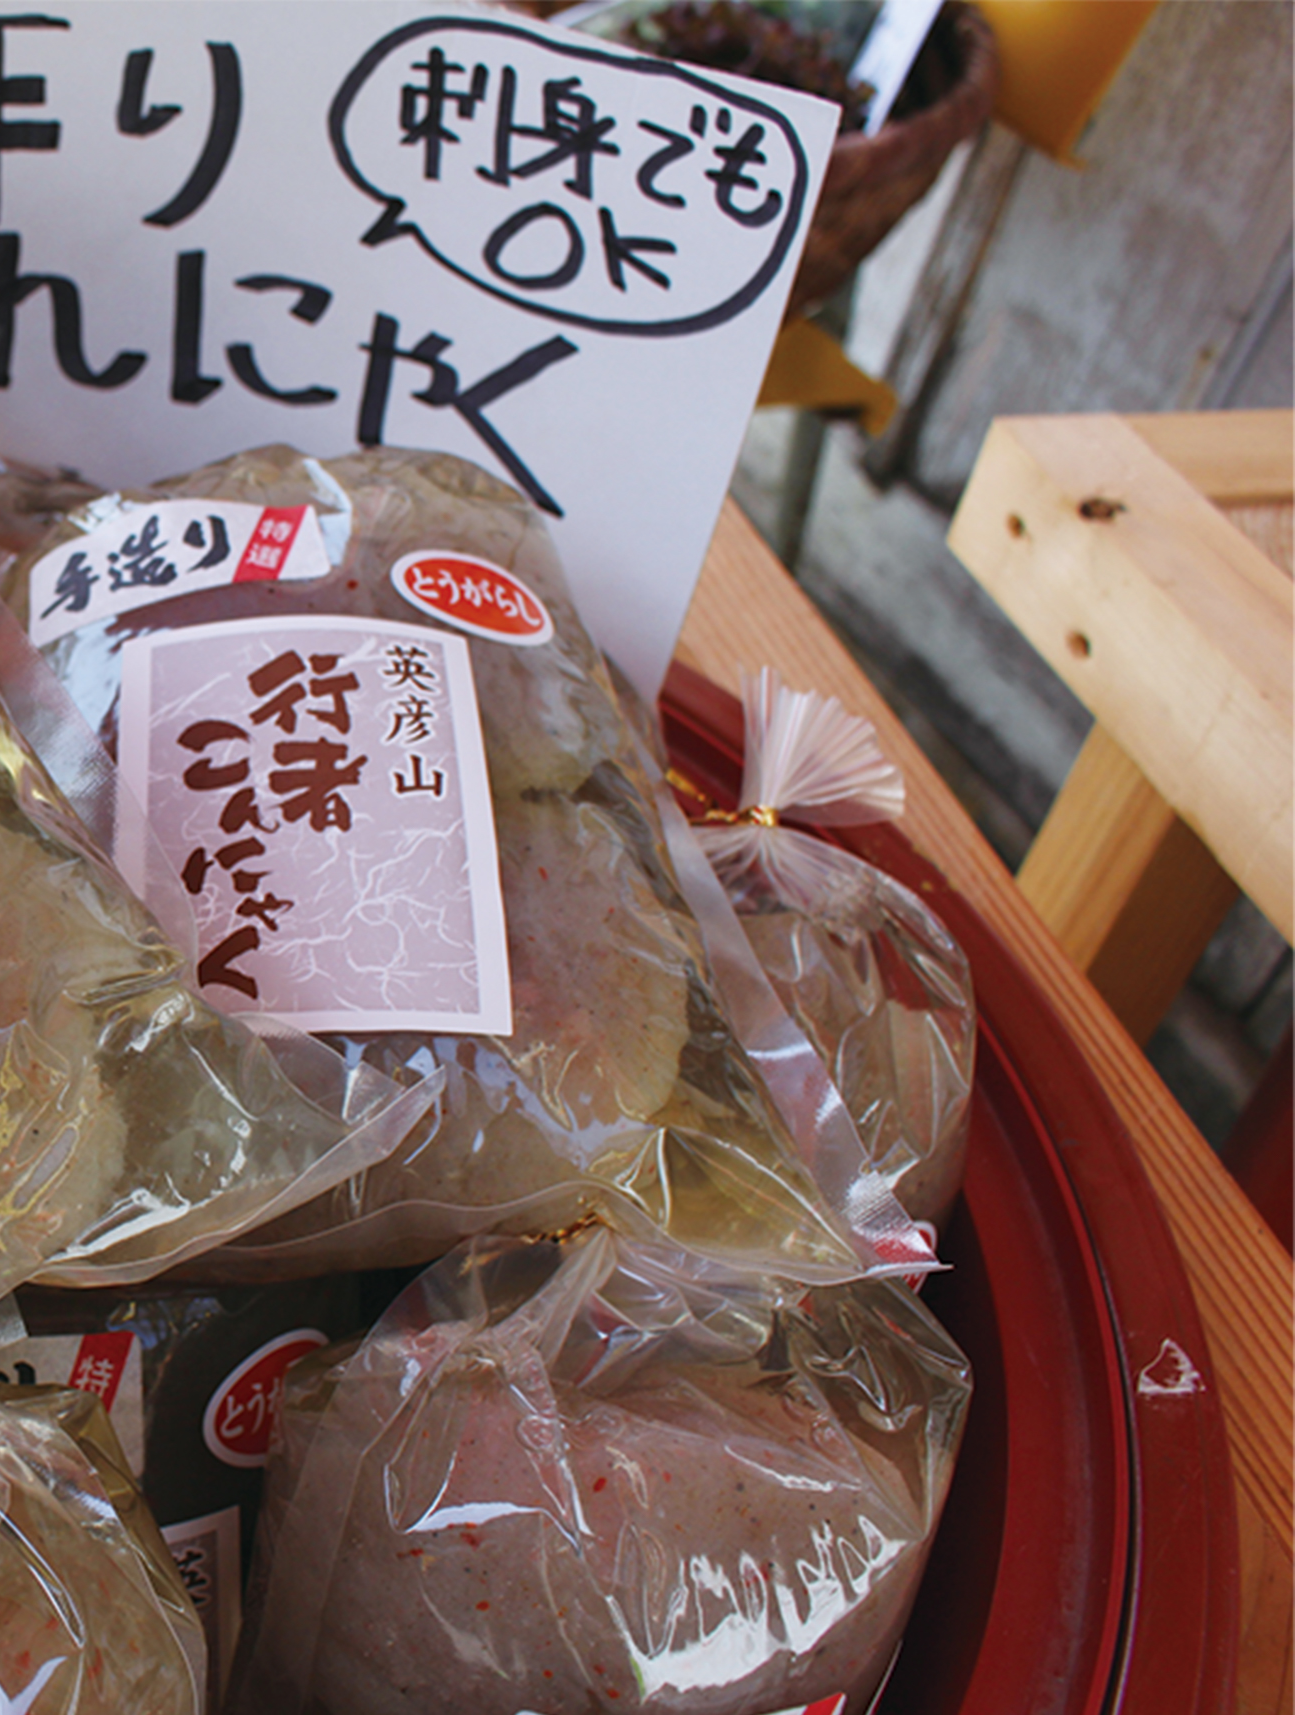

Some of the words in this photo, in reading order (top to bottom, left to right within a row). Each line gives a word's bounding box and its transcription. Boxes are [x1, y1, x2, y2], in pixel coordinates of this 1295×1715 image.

[398, 47, 783, 227] 刺身でも
[483, 202, 677, 291] OK
[40, 515, 233, 619] 手造り
[245, 513, 294, 571] 特選
[410, 567, 543, 628] とうがらし
[247, 649, 368, 833] 行者
[382, 645, 444, 798] 英彦山
[176, 718, 295, 999] こんにゃく
[76, 1355, 114, 1396] 特
